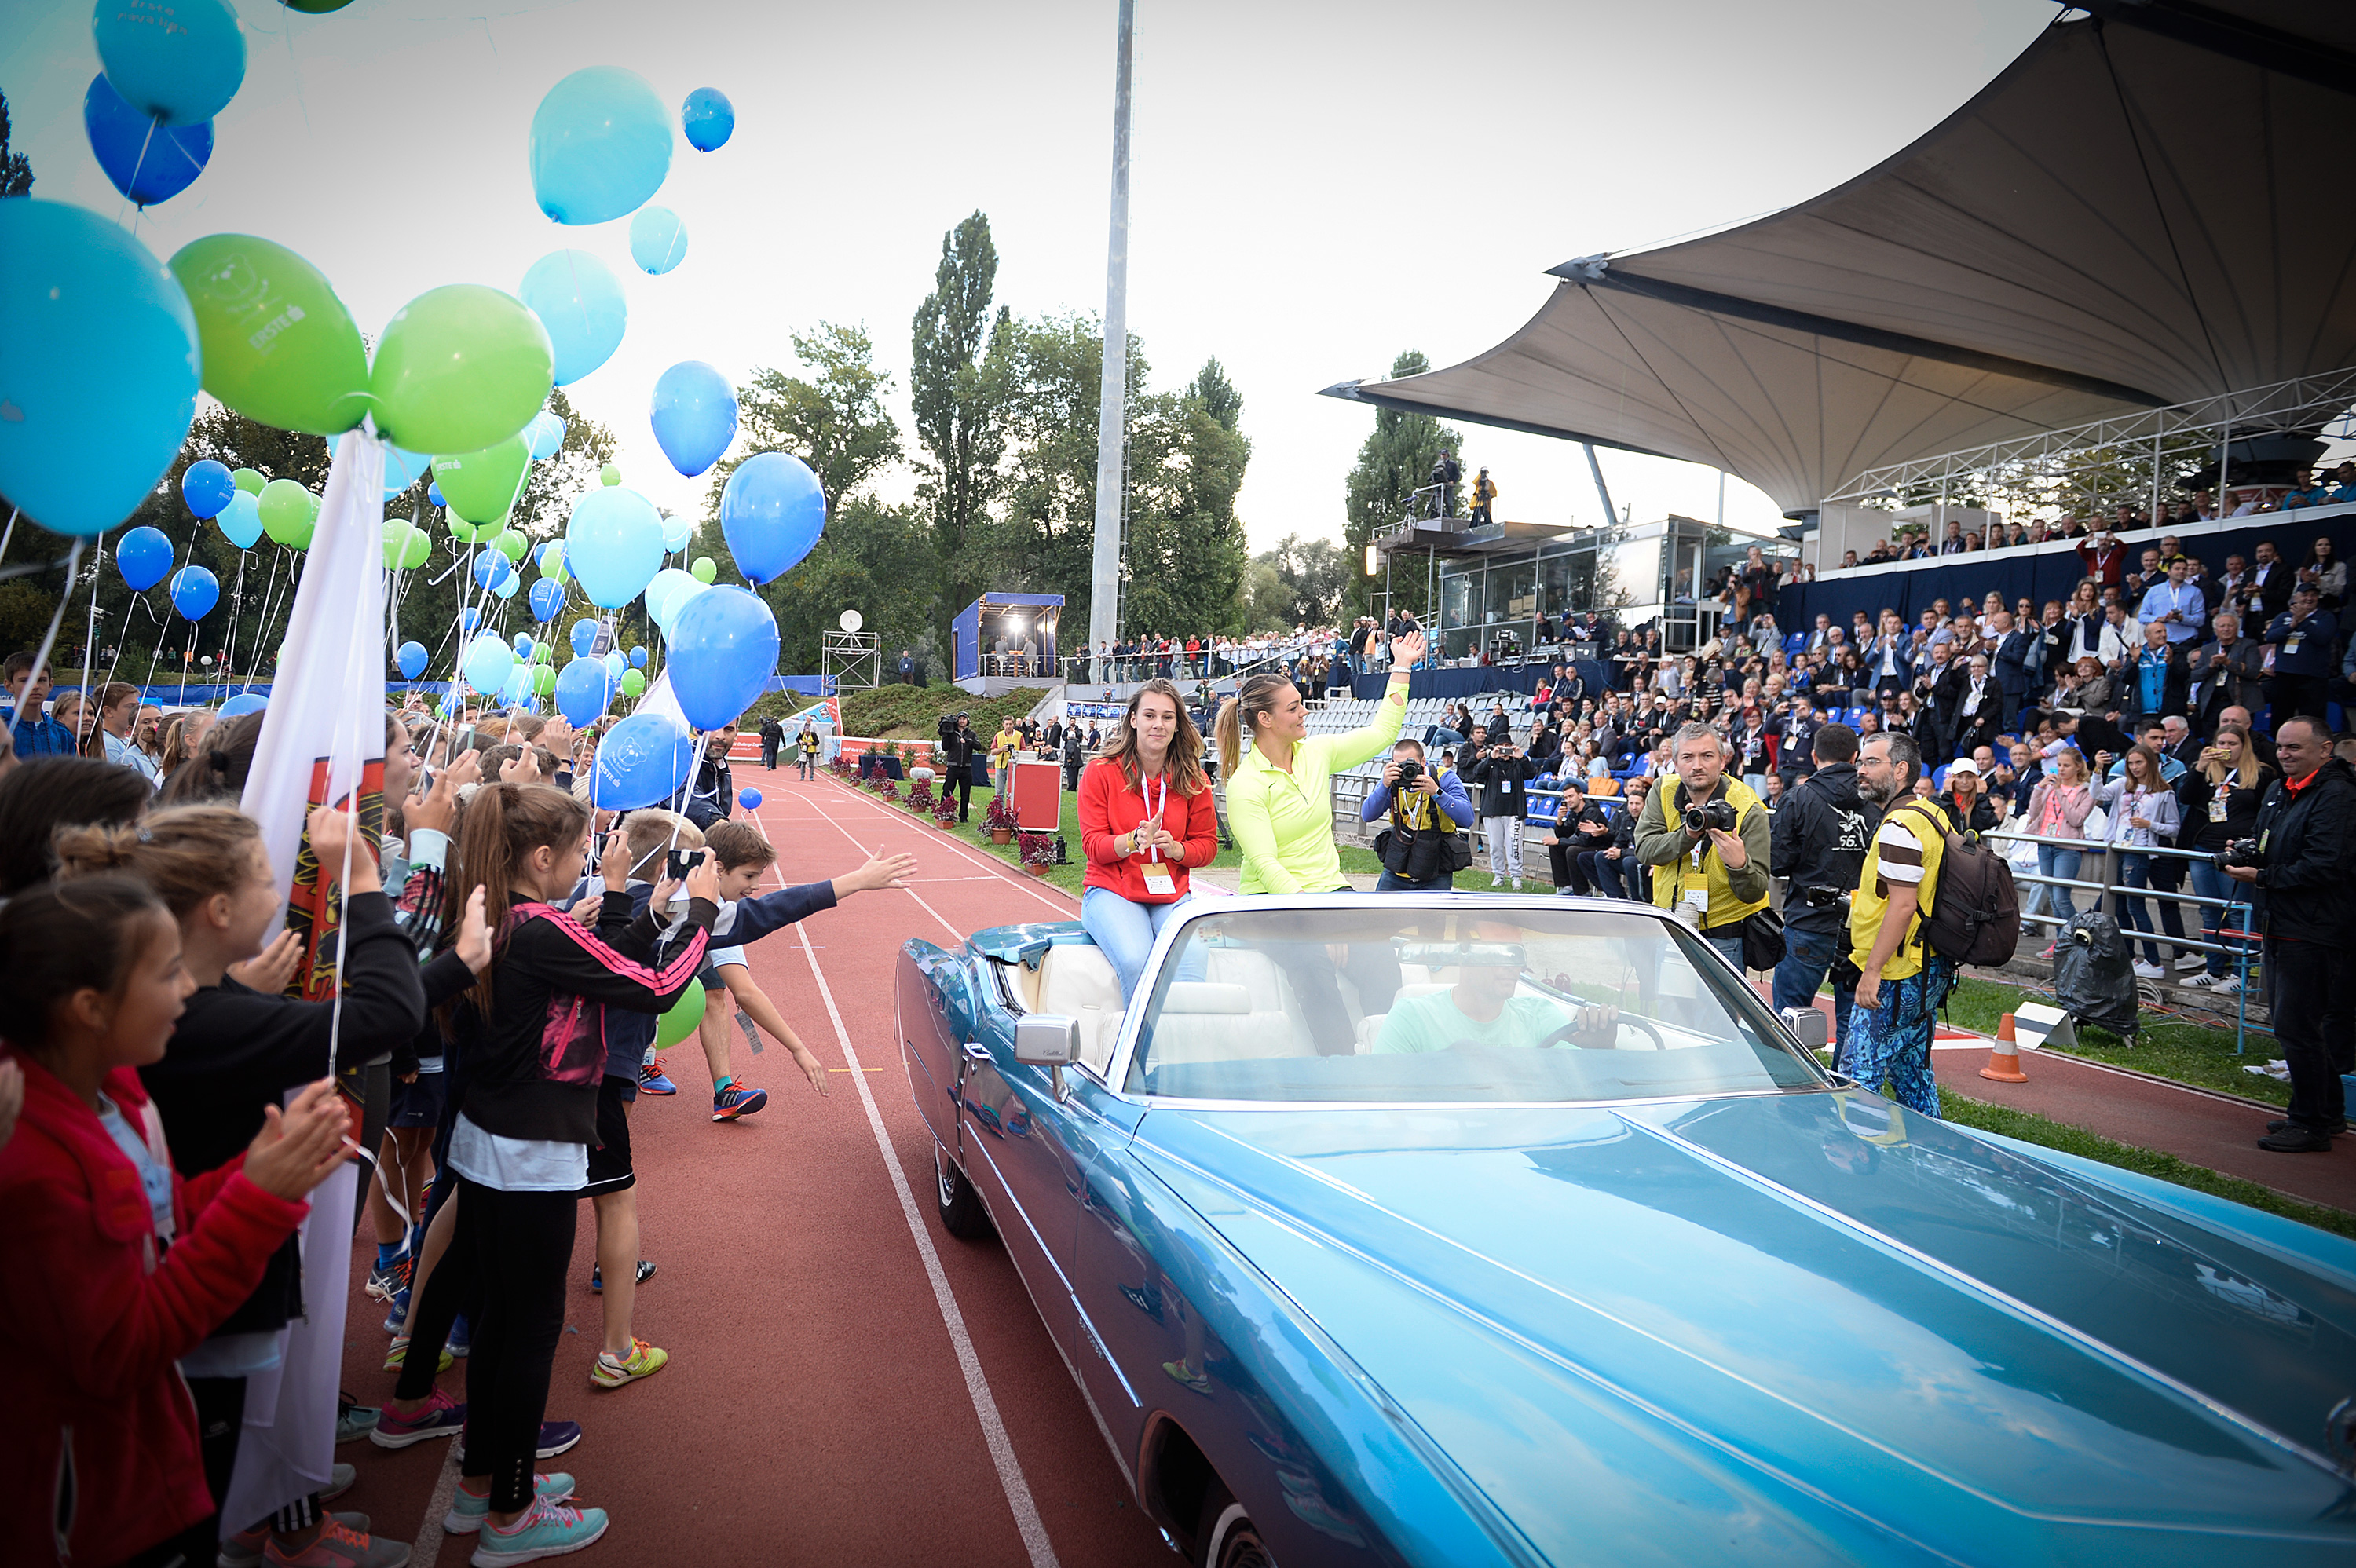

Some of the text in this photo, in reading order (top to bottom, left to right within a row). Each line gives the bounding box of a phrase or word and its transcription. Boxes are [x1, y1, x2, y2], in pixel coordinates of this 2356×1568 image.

[248, 314, 293, 350] ERSTE
[436, 462, 453, 472] ERSTE
[599, 761, 615, 781] ERSTE
[1839, 835, 1857, 847] 56.
